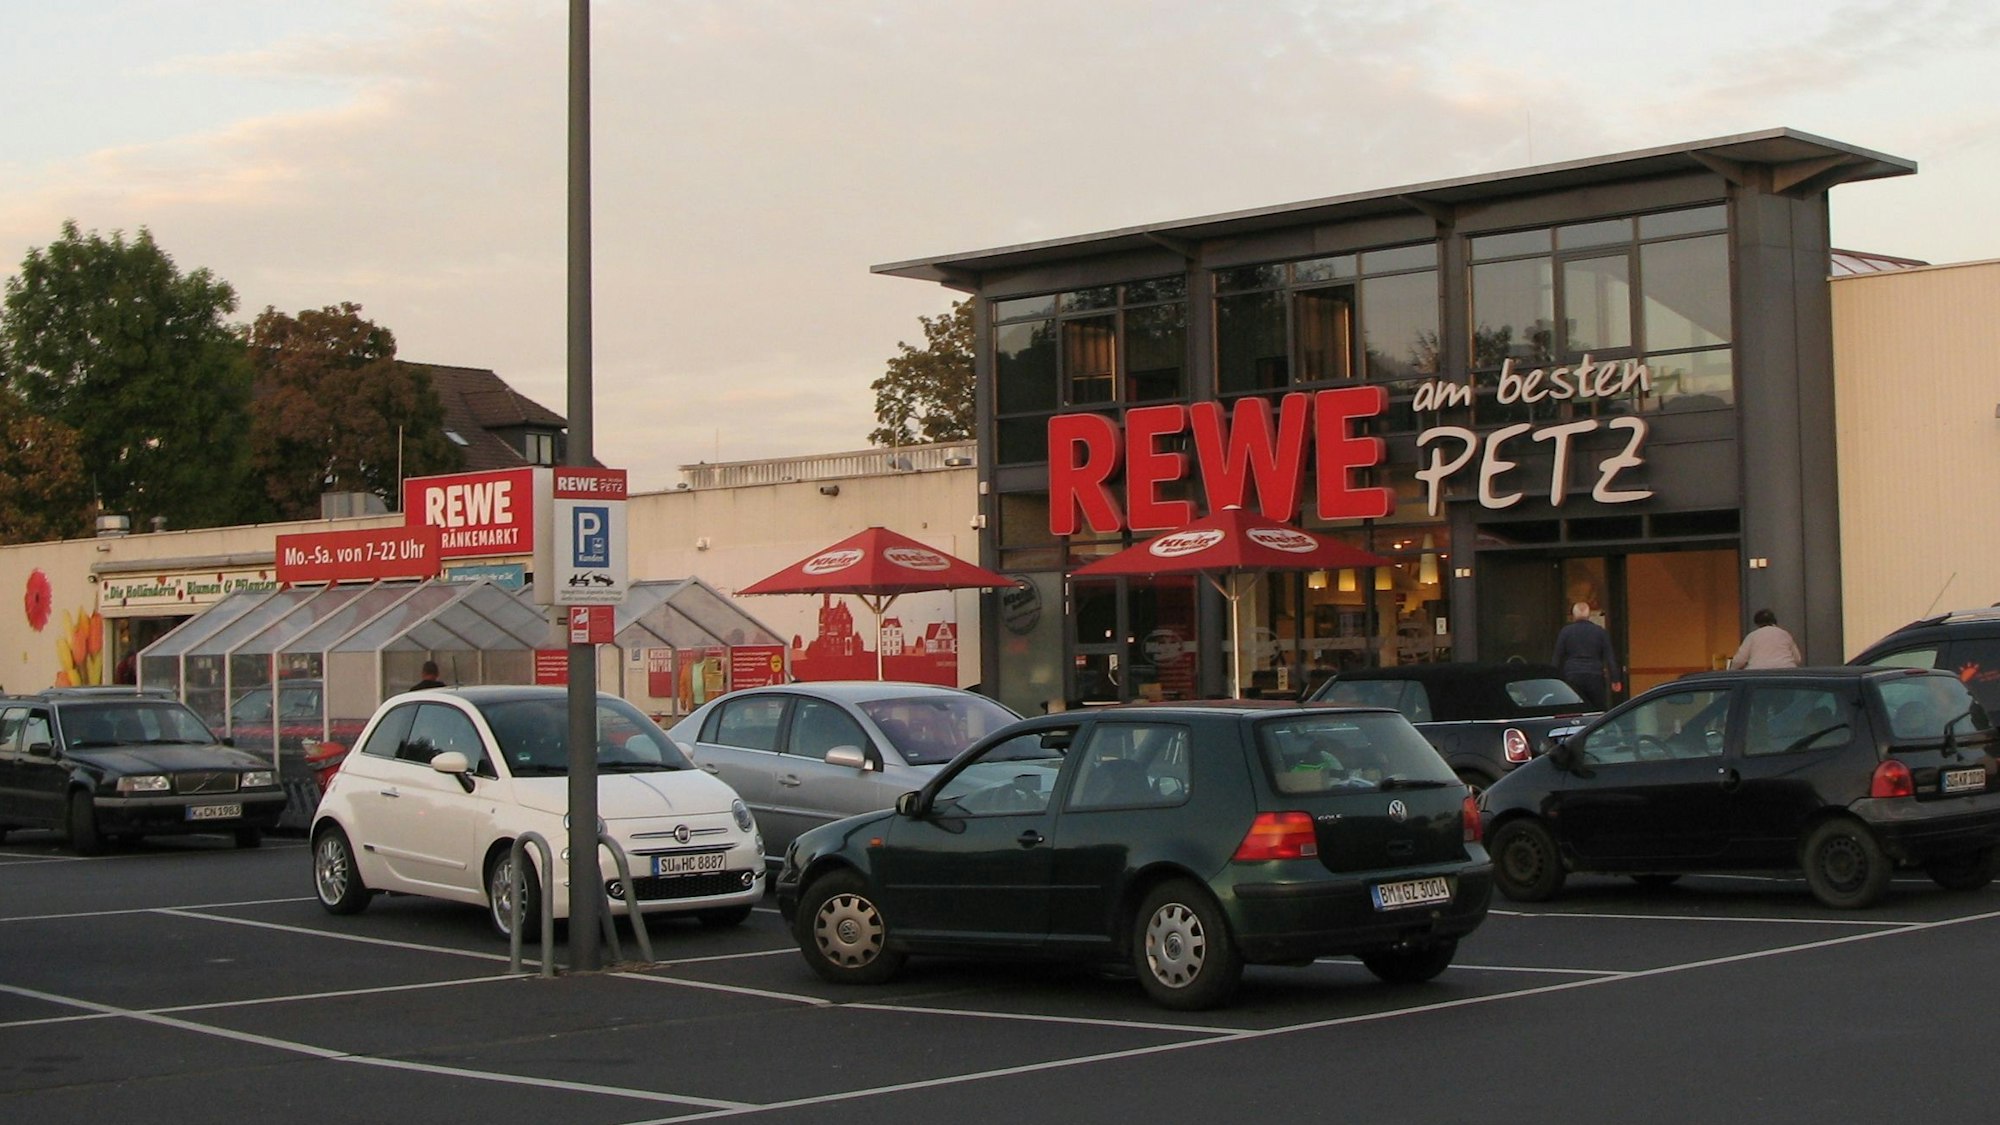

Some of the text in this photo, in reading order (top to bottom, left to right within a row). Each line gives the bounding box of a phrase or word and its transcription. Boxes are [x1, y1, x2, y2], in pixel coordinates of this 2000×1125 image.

[1413, 353, 1651, 412] am besten
[1047, 385, 1396, 536] REWE
[1414, 416, 1656, 517] PETZ
[557, 476, 598, 492] REWE
[425, 480, 513, 528] REWE
[336, 548, 363, 563] von
[399, 538, 426, 560] Uhr
[441, 528, 519, 549] RÄNKEMARKT
[186, 581, 221, 595] Blumen
[660, 854, 724, 873] SU HC 8887
[1380, 879, 1447, 904] BM GZ 3004
